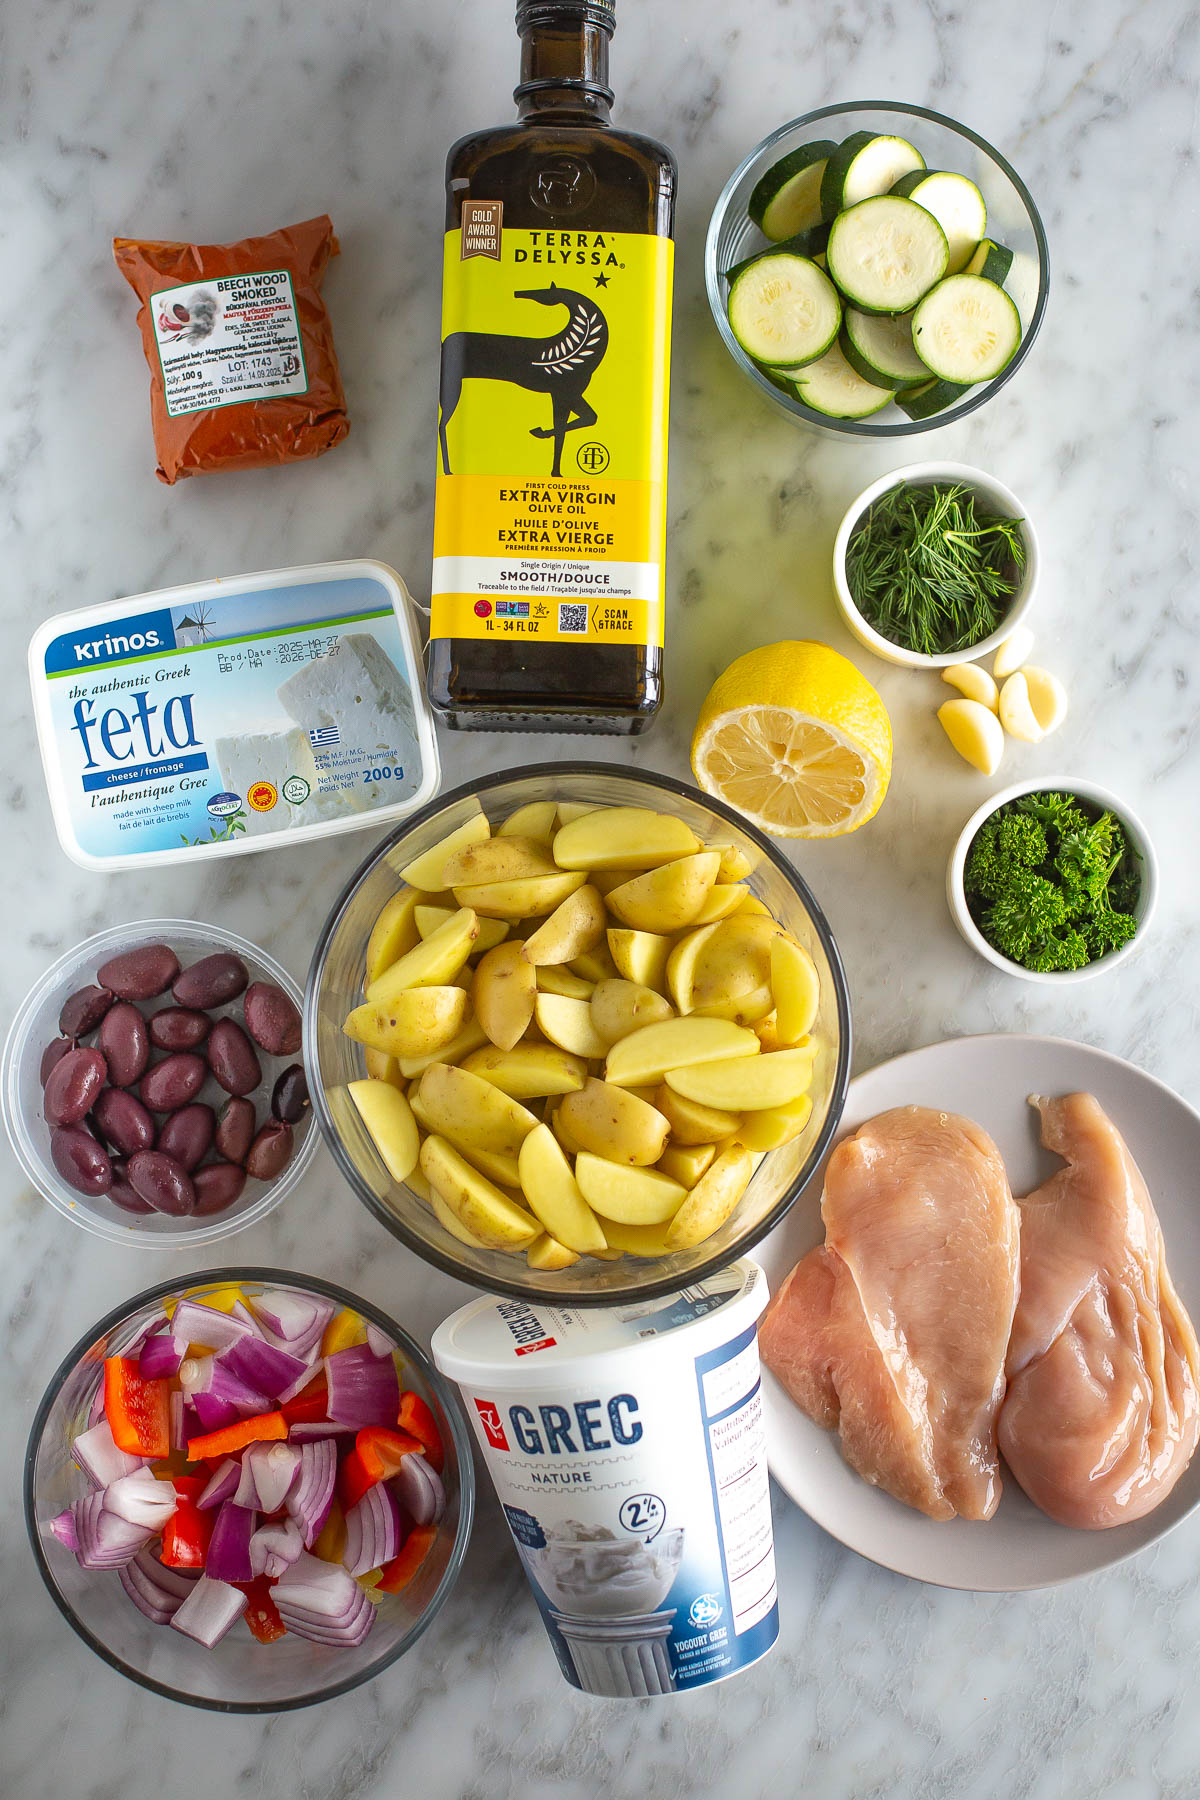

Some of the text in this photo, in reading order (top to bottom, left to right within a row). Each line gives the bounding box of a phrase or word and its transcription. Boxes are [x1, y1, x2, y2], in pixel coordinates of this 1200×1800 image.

[472, 210, 492, 222] GOLD
[467, 224, 496, 236] AWARD
[465, 237, 497, 250] WINNER
[529, 232, 607, 248] TERRA
[217, 273, 287, 292] BEECH WOOD
[231, 286, 277, 302] SMOKED
[227, 356, 272, 373] LOT: 1743
[181, 370, 196, 381] 100
[196, 371, 203, 380] g
[499, 489, 616, 505] EXTRA VIRGIN
[528, 504, 586, 515] OLIVE OIL
[513, 519, 599, 531] HUILE D'OLIVE
[498, 530, 614, 545] EXTRA VIERGE
[540, 545, 576, 553] PRESSION
[520, 561, 541, 570] Single
[541, 562, 562, 570] Origin
[567, 563, 590, 571] Unique
[500, 571, 610, 585] SMOOTH/DOUCE
[477, 582, 509, 591] Traceable
[510, 584, 518, 592] to
[518, 583, 529, 592] the
[530, 584, 545, 592] field
[551, 585, 578, 595] Traçable
[579, 586, 606, 595] jusqu'au
[607, 587, 632, 596] champs
[604, 609, 628, 620] SCAN
[485, 620, 494, 631] 1L
[503, 620, 514, 632] 34
[516, 621, 526, 632] FL
[528, 621, 539, 633] OZ
[598, 619, 633, 631] &TRACE
[73, 630, 160, 661] krinos
[219, 662, 233, 673] BB
[249, 658, 263, 669] MA
[69, 664, 191, 700] the authentic Greek
[70, 691, 204, 770] feta
[313, 753, 330, 763] 22%
[330, 750, 344, 760] M.F.
[315, 761, 332, 771] 55%
[332, 757, 362, 769] Moisture
[366, 748, 398, 763] Humidité
[106, 770, 139, 783] cheese
[144, 761, 185, 777] fromage
[317, 770, 360, 785] Net Weight
[362, 766, 405, 784] 200 g
[91, 777, 208, 808] l'authentique Grec
[319, 780, 355, 793] Poids Net
[112, 798, 192, 820] made with sheep milk
[119, 810, 190, 831] fait de lait de brebis
[508, 1393, 644, 1455] GREC
[531, 1471, 593, 1484] NATURE
[627, 1496, 657, 1528] 2%
[673, 1633, 708, 1653] YOGOURT
[709, 1626, 728, 1642] GREC
